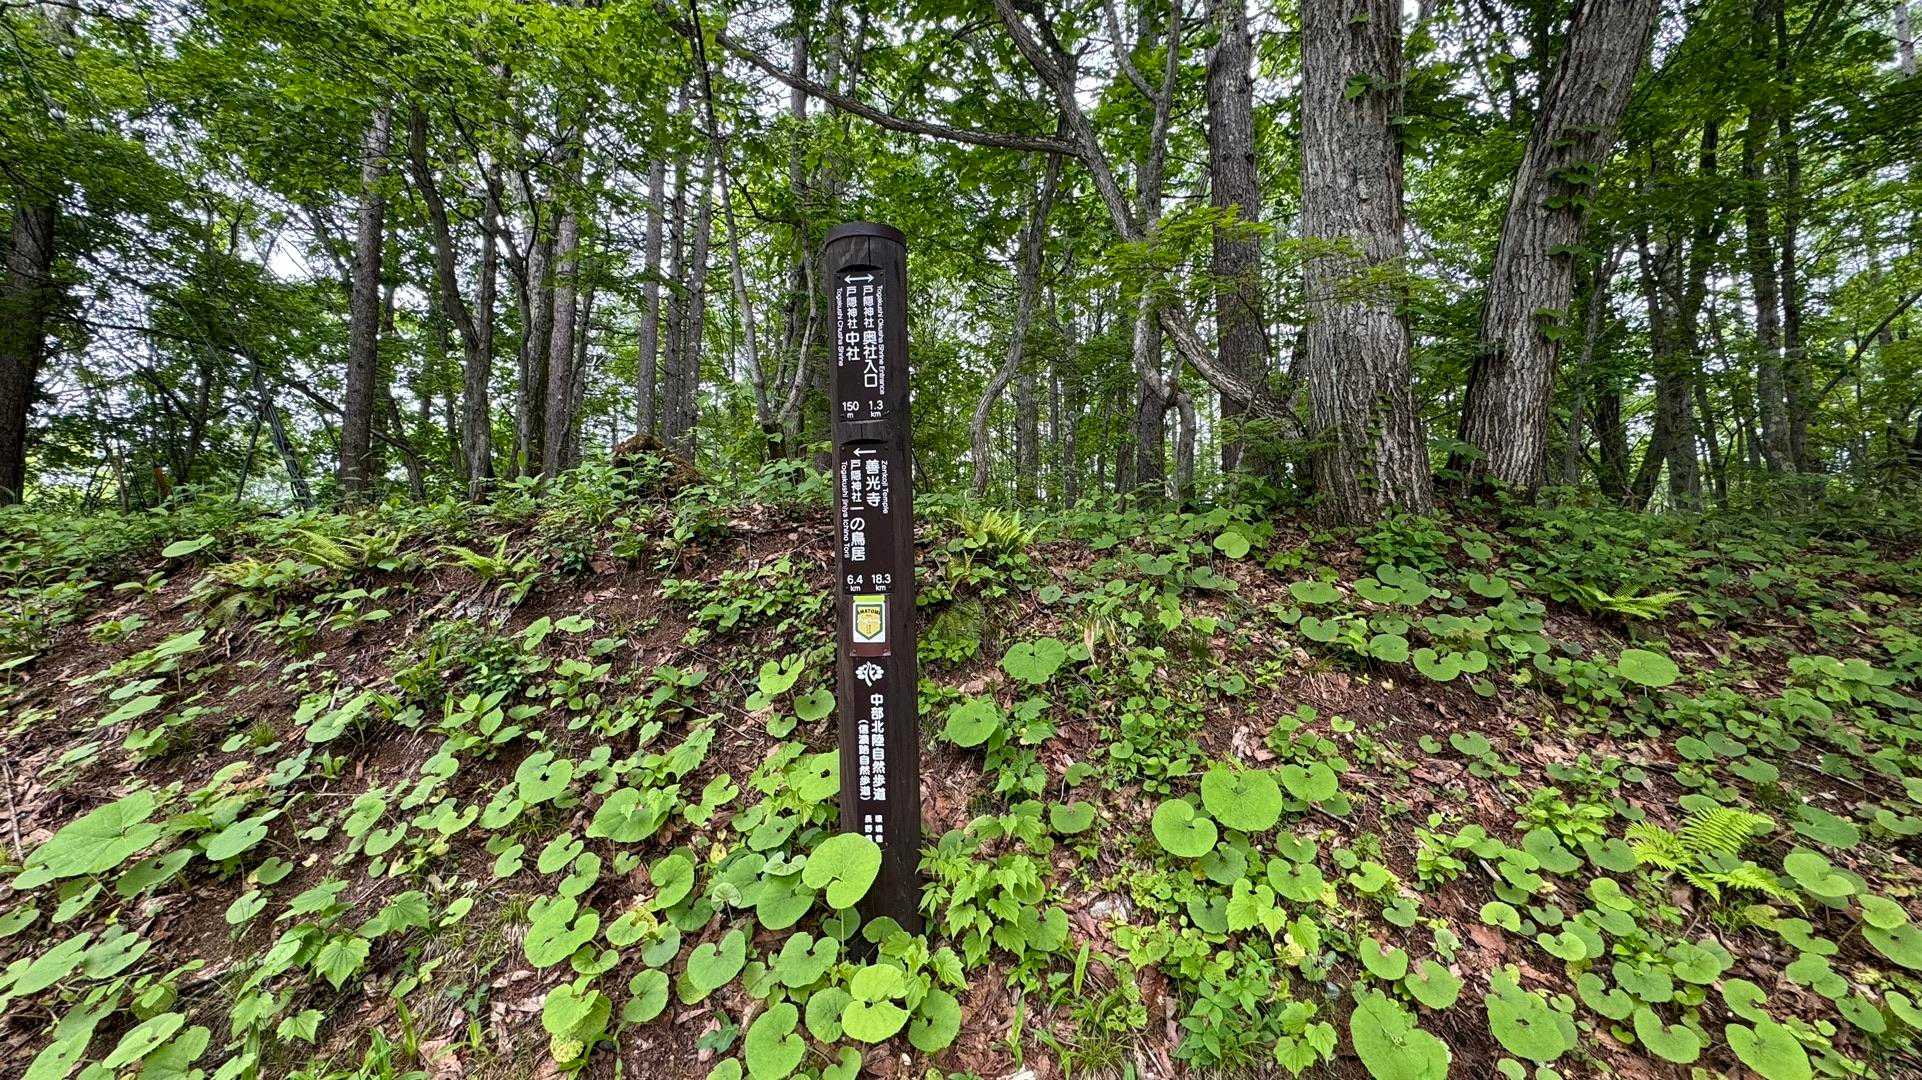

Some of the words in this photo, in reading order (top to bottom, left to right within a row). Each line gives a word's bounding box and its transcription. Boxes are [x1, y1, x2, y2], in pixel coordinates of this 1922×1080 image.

[842, 401, 859, 411] 150
[868, 400, 883, 411] 1.3
[865, 459, 881, 507] 善光寺
[847, 575, 863, 585] 6.4
[871, 574, 891, 584] 18.3
[870, 693, 886, 801] 中部北陸自然歩道
